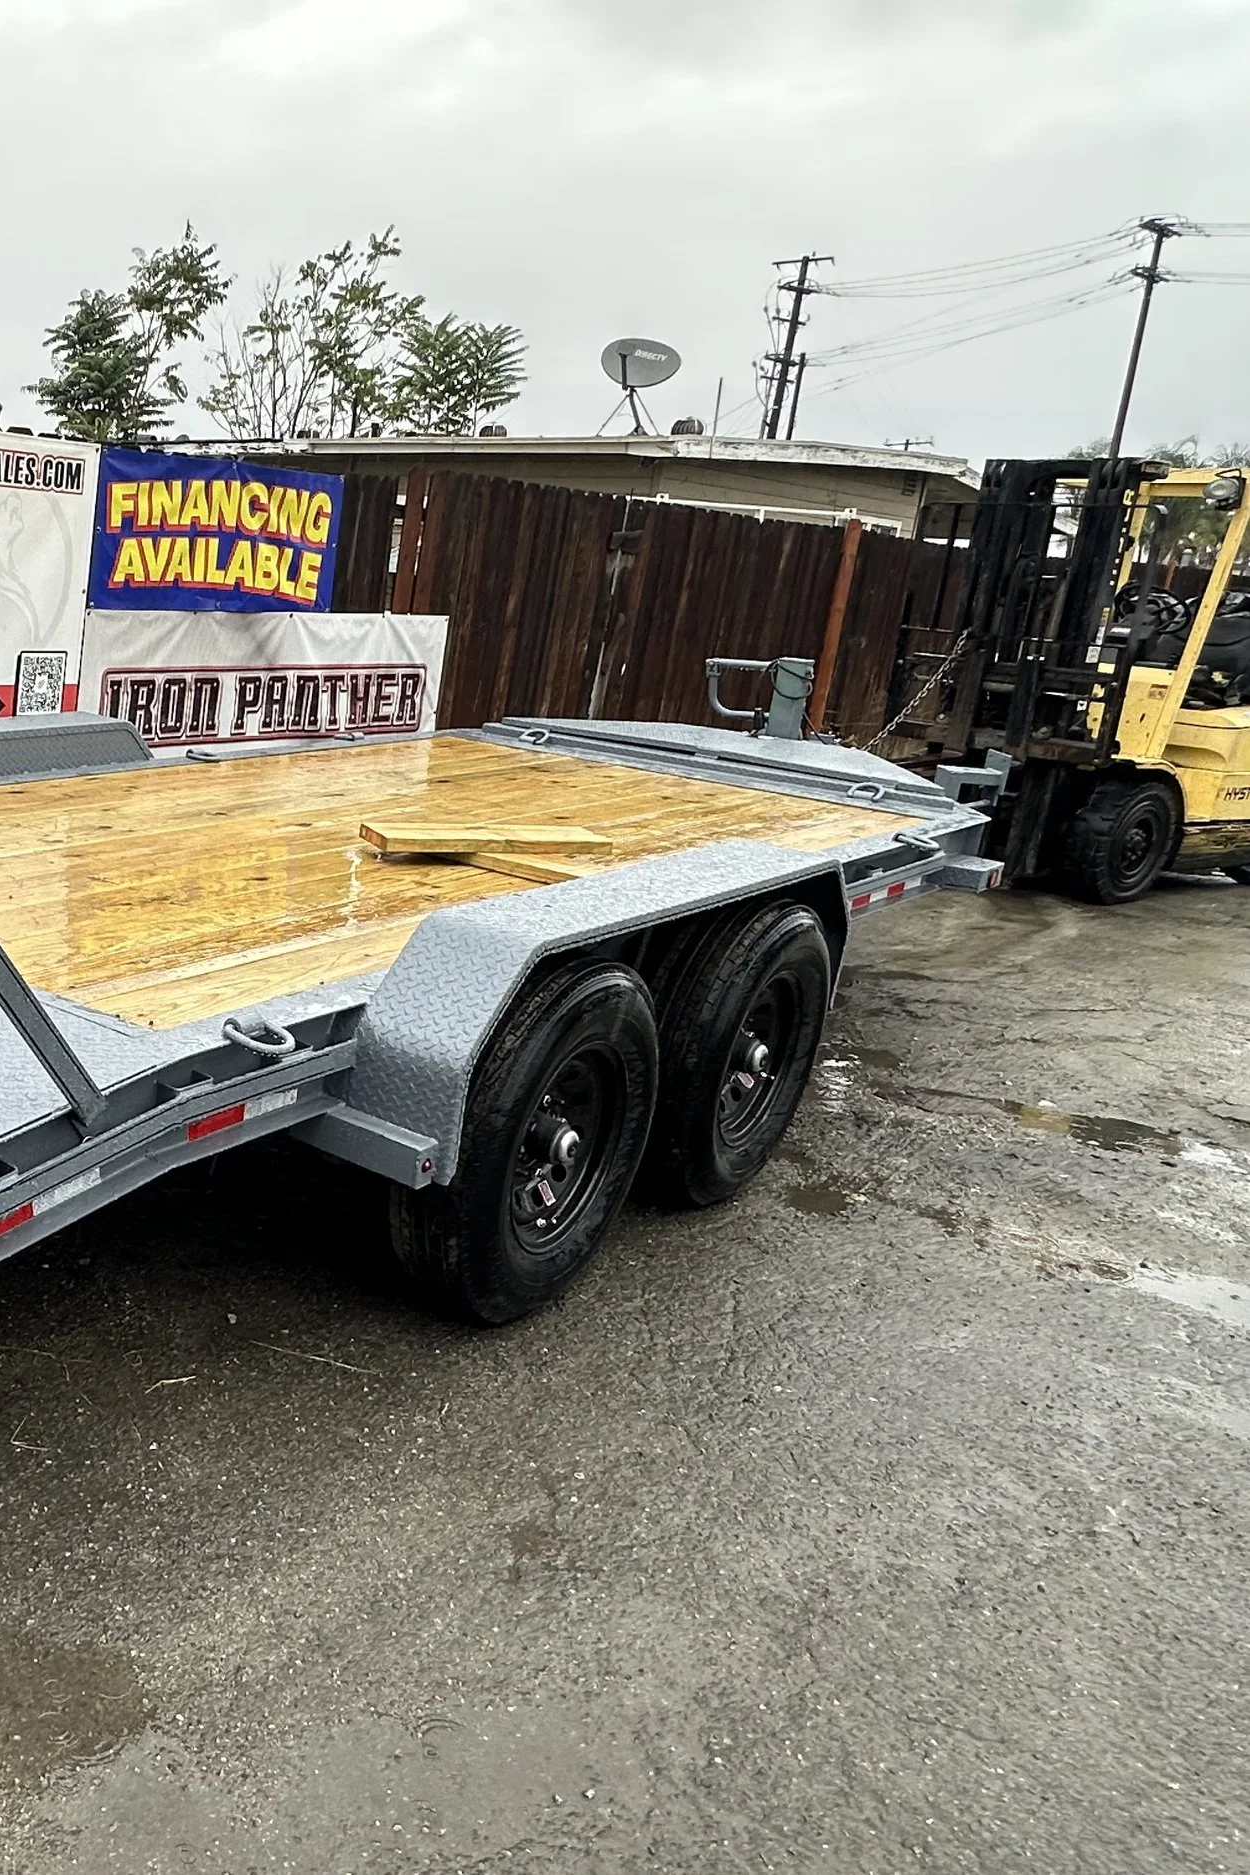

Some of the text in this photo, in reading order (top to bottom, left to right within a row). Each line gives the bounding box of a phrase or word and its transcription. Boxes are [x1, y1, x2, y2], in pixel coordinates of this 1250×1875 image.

[108, 479, 333, 547] FINANCING
[110, 537, 323, 604] AVAILABLE
[106, 670, 422, 740] IRON PANTHER
